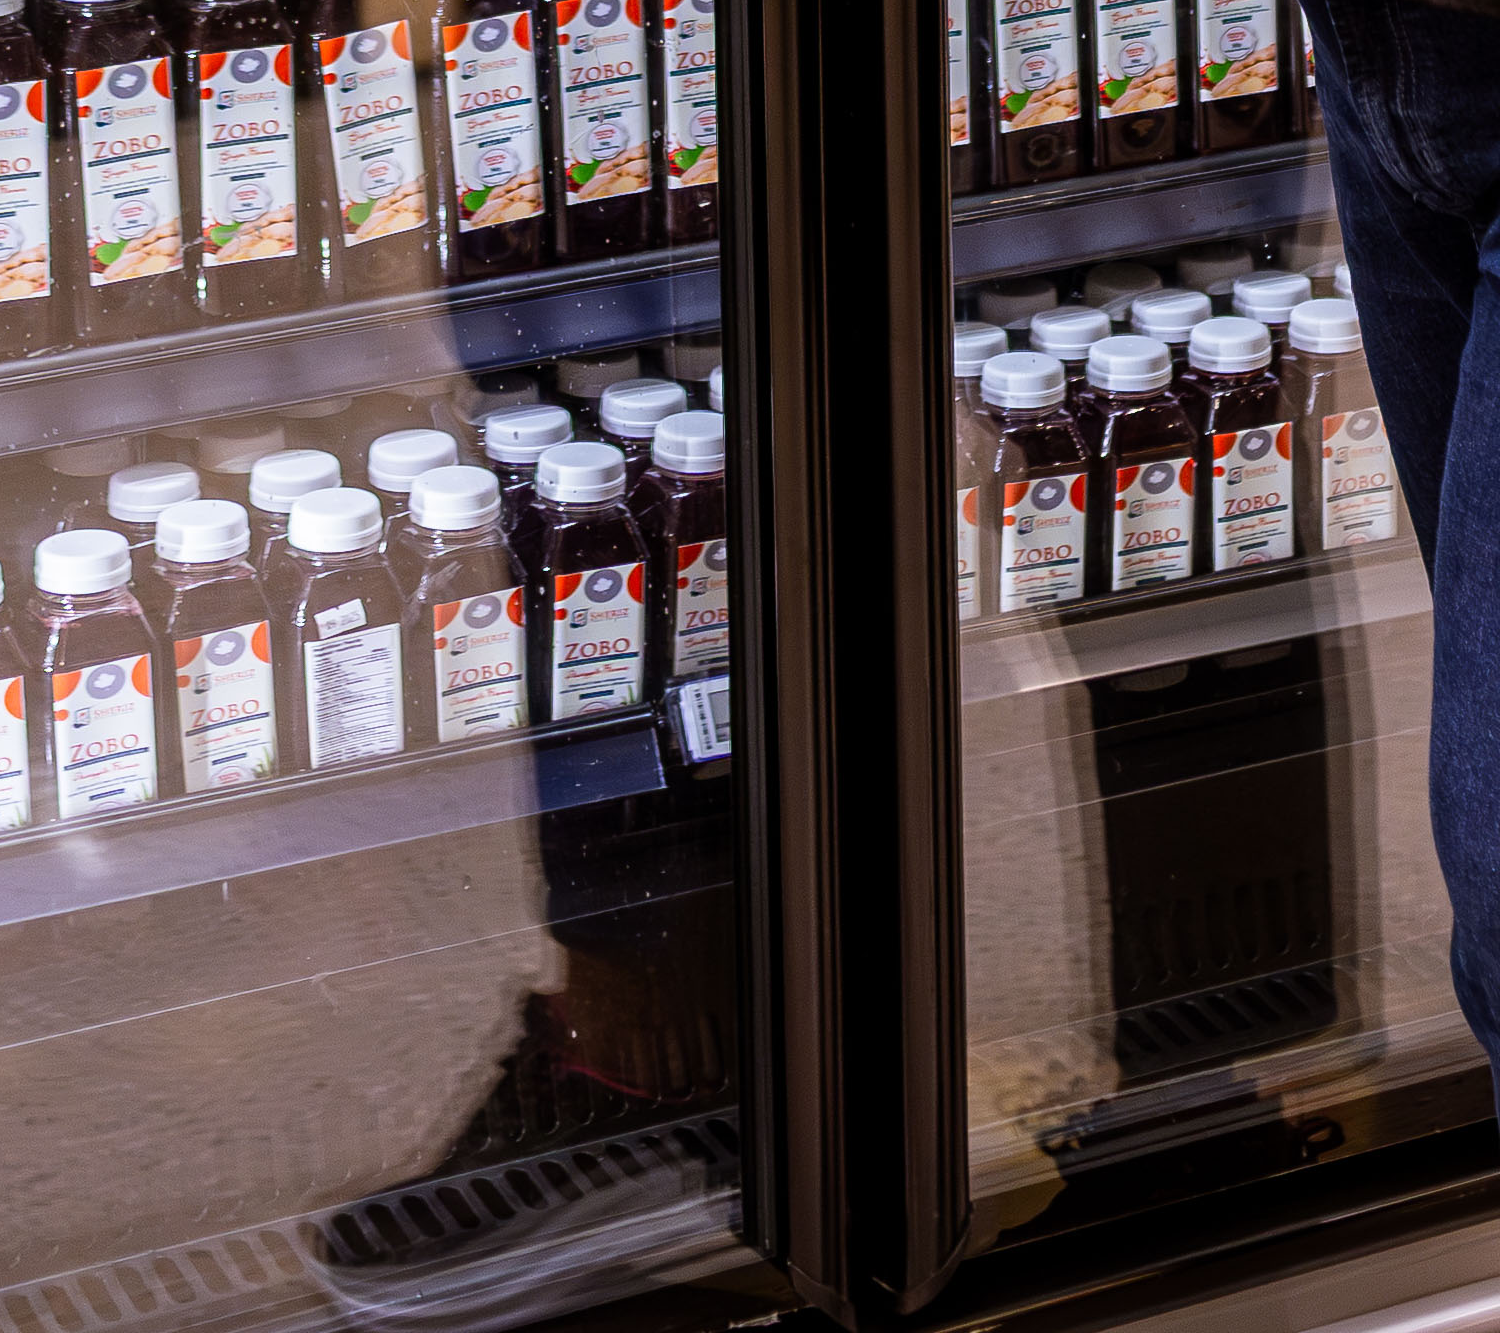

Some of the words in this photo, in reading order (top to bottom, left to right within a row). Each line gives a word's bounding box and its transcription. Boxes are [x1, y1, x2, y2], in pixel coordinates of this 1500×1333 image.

[569, 60, 634, 85] ZOBO
[340, 94, 404, 123] ZOBO
[459, 85, 524, 113] ZOBO
[212, 118, 280, 142] ZOBO
[92, 133, 161, 159] ZOBO
[1331, 472, 1386, 493] ZOBO
[1224, 492, 1281, 515] ZOBO
[1124, 527, 1181, 549] ZOBO
[1013, 543, 1072, 566] ZOBO
[564, 637, 630, 661] ZOBO
[447, 660, 513, 689] ZOBO
[191, 698, 261, 728] ZOBO
[70, 733, 139, 763] ZOBO
